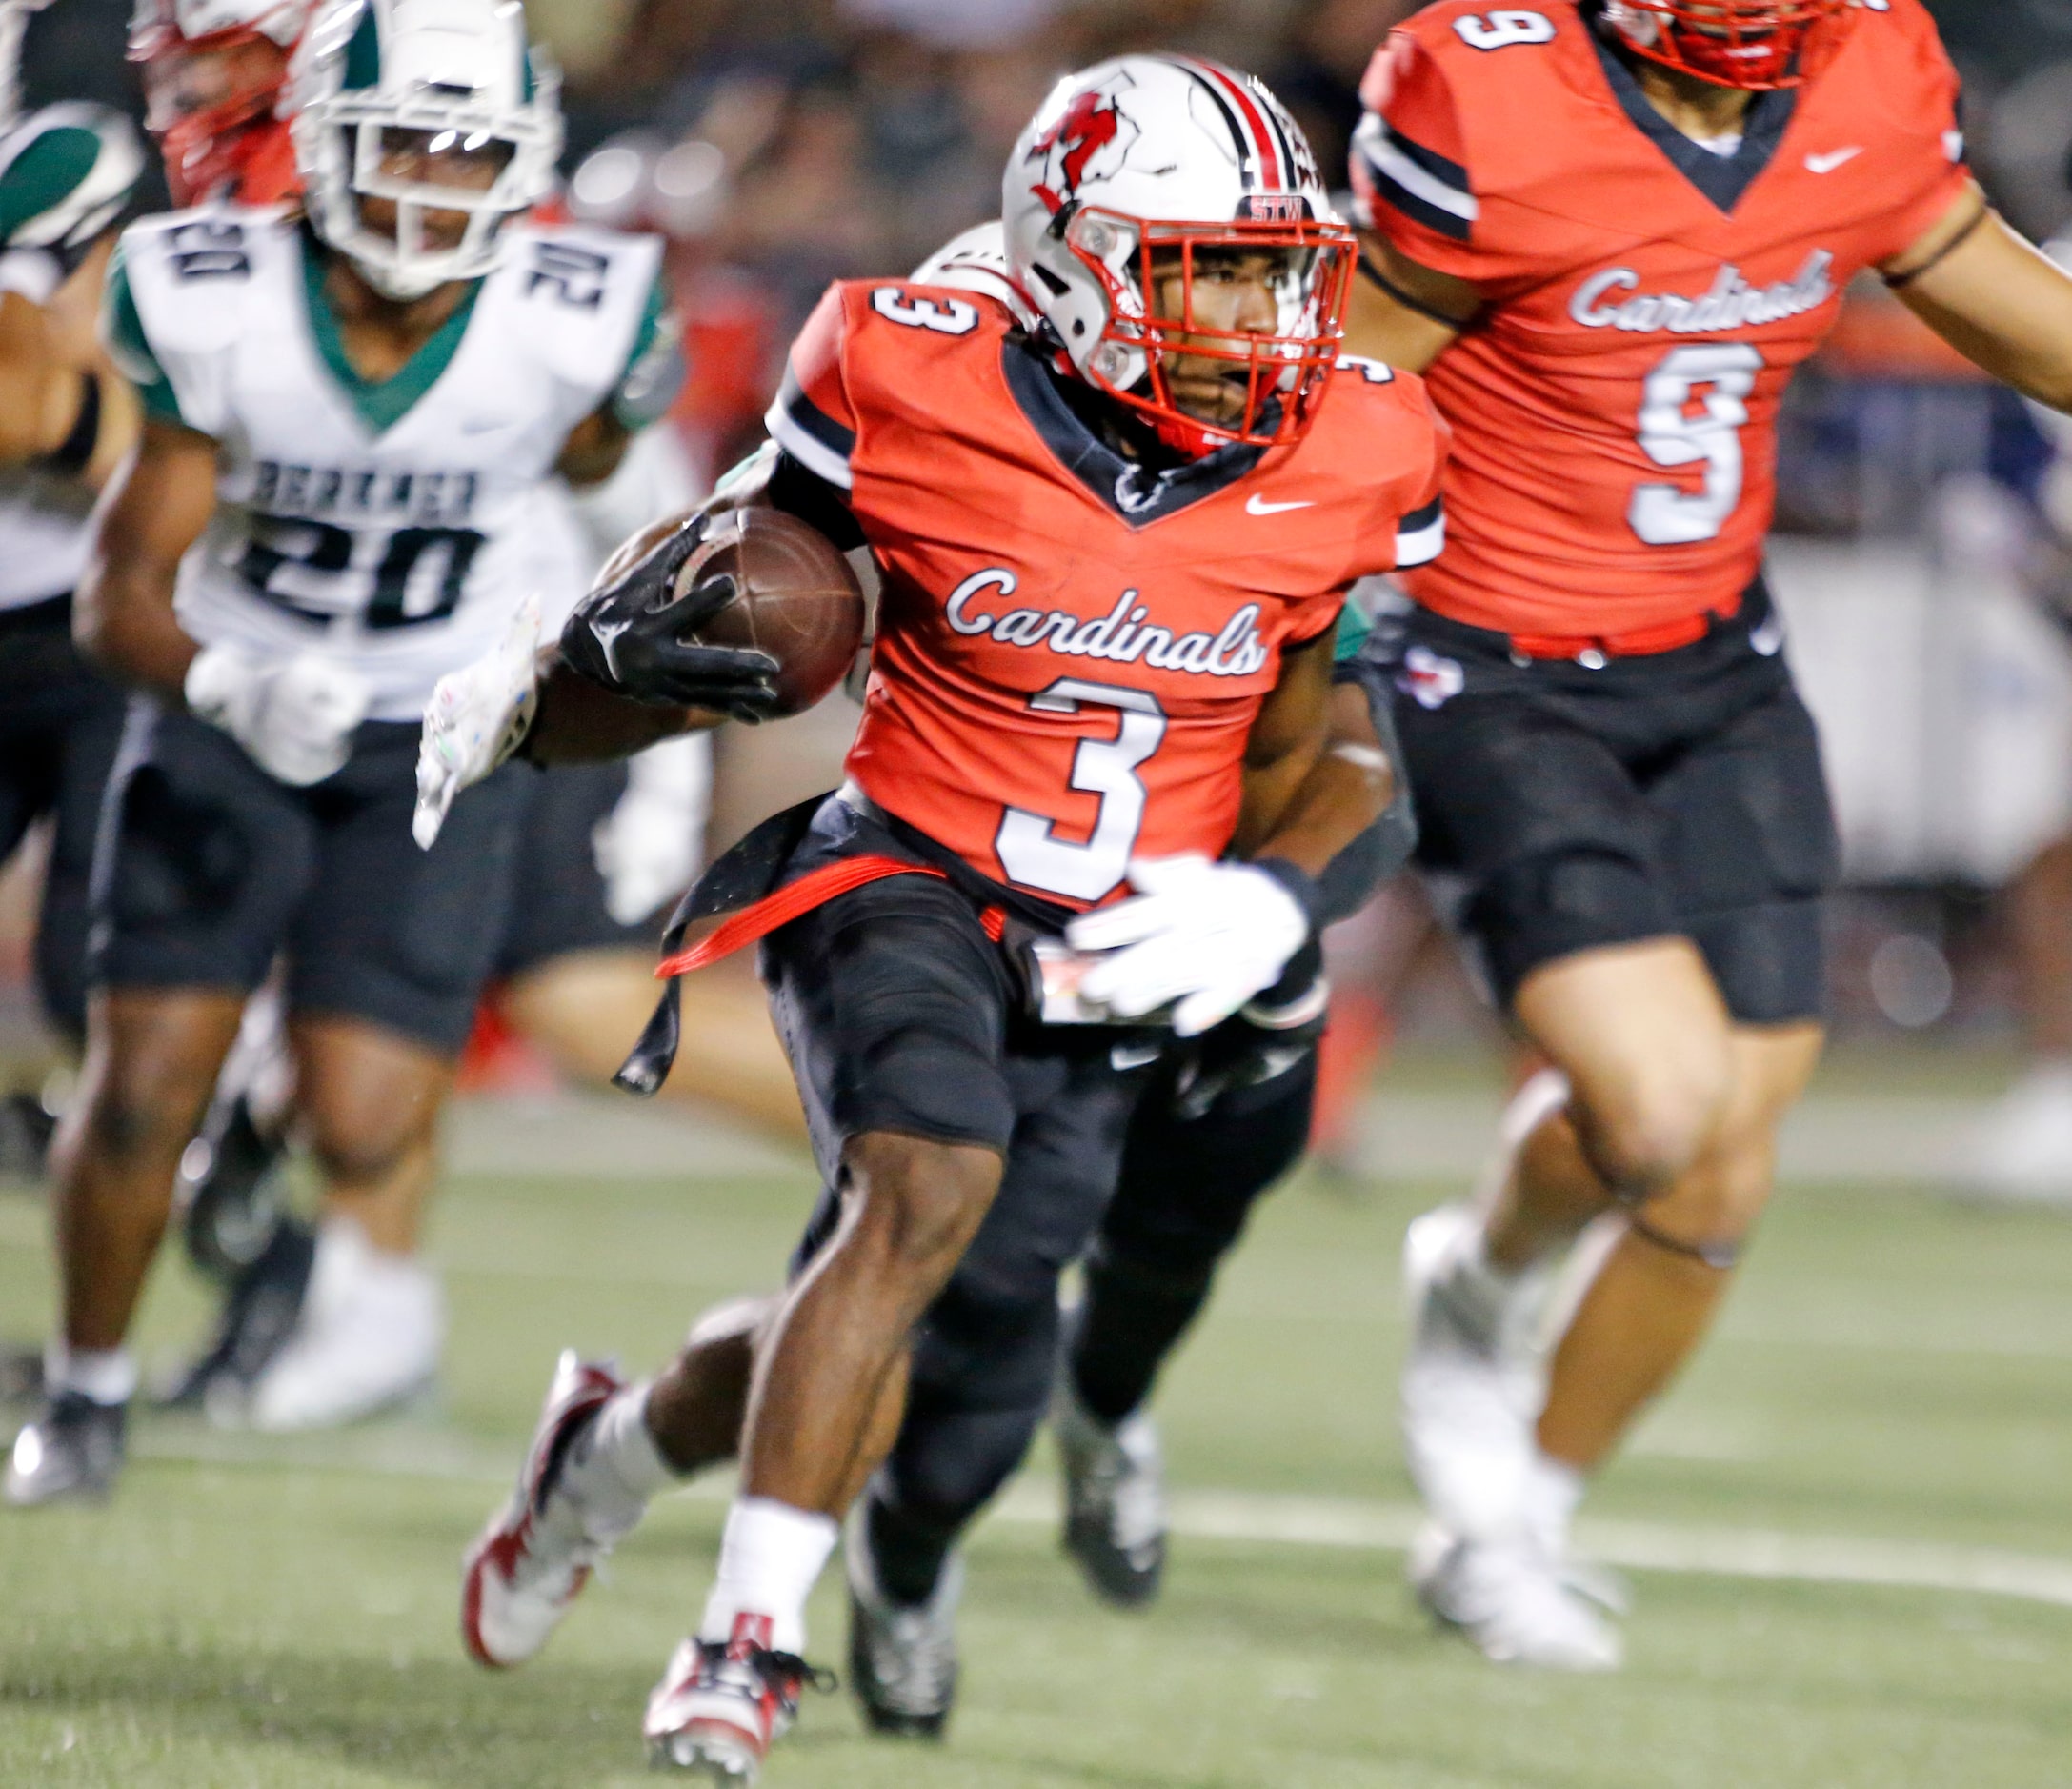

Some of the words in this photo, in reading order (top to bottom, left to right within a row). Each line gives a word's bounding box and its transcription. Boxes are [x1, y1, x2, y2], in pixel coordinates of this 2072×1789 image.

[1451, 9, 1557, 51] 9
[1250, 196, 1303, 222] STW
[868, 286, 979, 336] 3
[1627, 343, 1763, 546] 9
[238, 511, 488, 631] 20
[945, 567, 1265, 676] Cardinals
[993, 675, 1166, 903] 3
